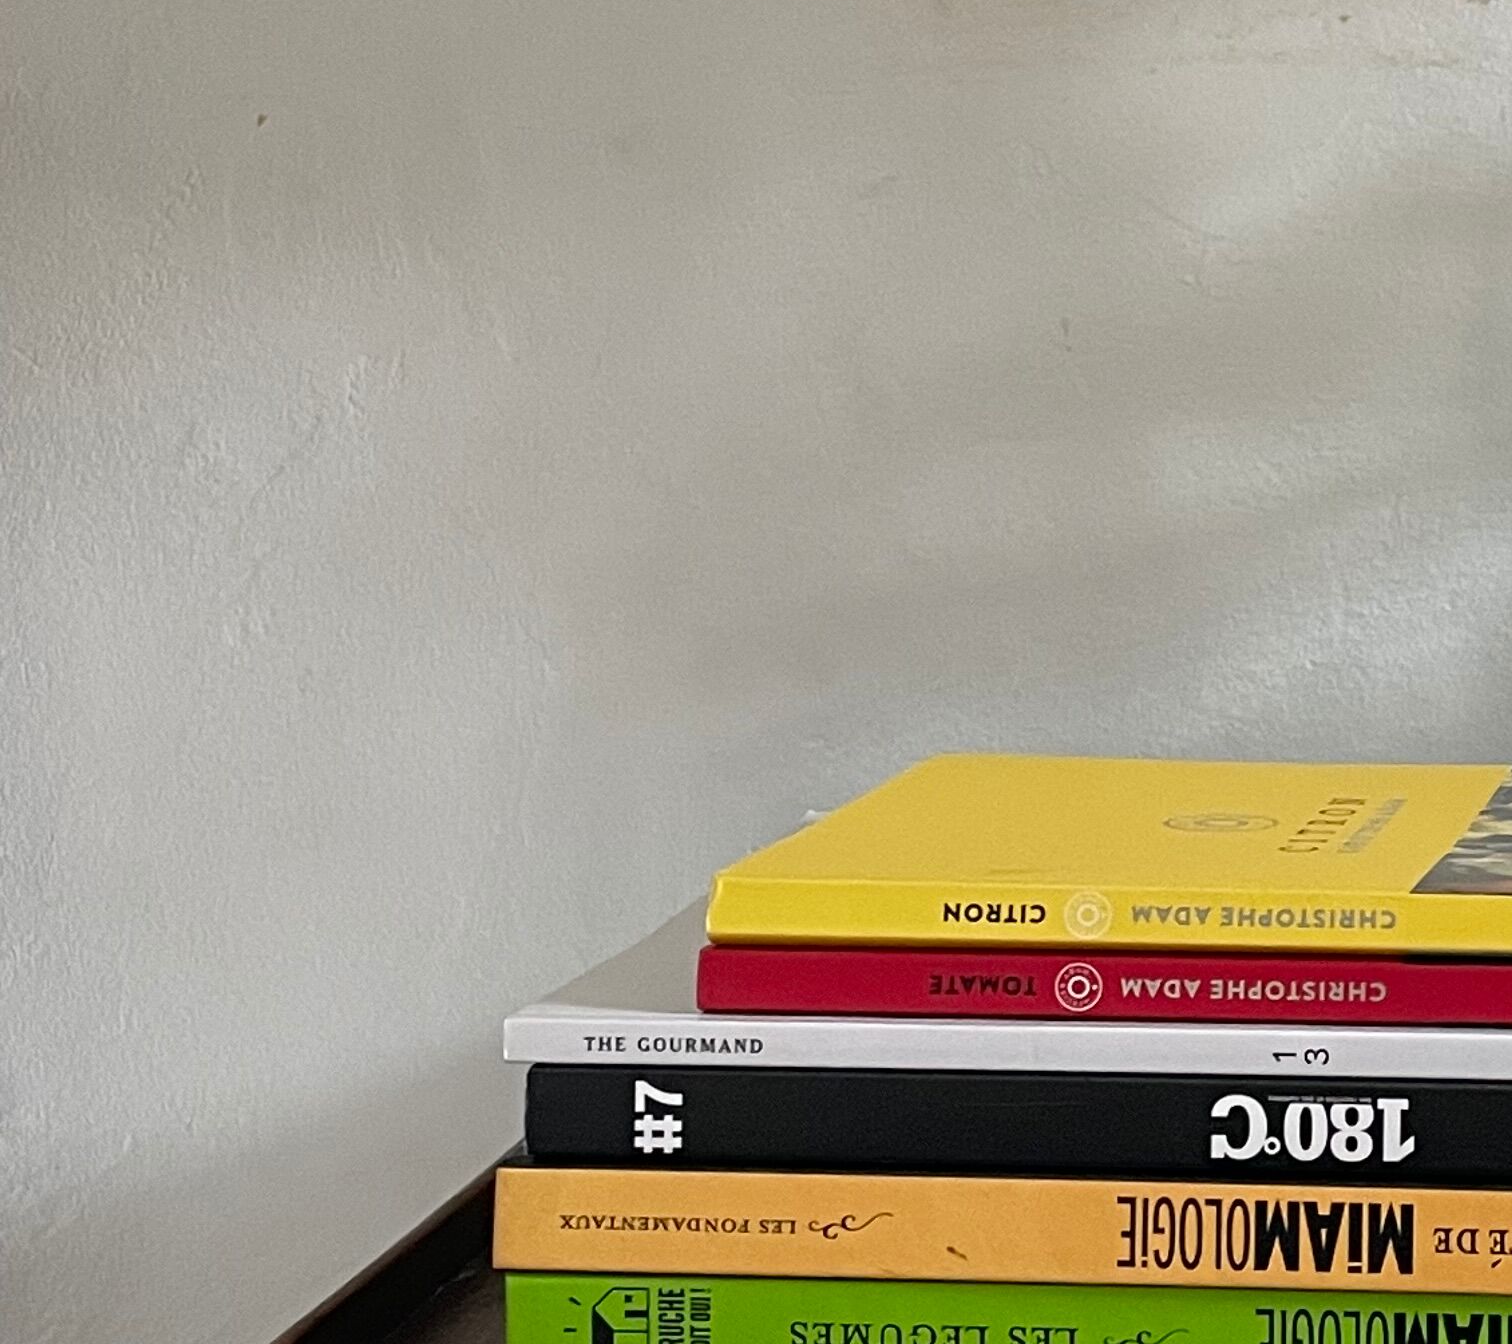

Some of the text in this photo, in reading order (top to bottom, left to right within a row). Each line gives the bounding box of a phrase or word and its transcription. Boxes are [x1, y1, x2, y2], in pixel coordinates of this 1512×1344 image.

[944, 903, 1045, 923] CITRON
[1131, 904, 1211, 927] ADAM
[1220, 907, 1396, 930] CHRISTOPHE
[930, 975, 1036, 997] TOMATE
[1121, 978, 1200, 998] ADAM
[1210, 980, 1386, 1001] CHRISTOPHE
[584, 1037, 763, 1053] THE GOURMAND
[634, 1080, 683, 1153] #7
[560, 1215, 796, 1234] LES FONDAMENTAUX
[1433, 1228, 1479, 1254] DE
